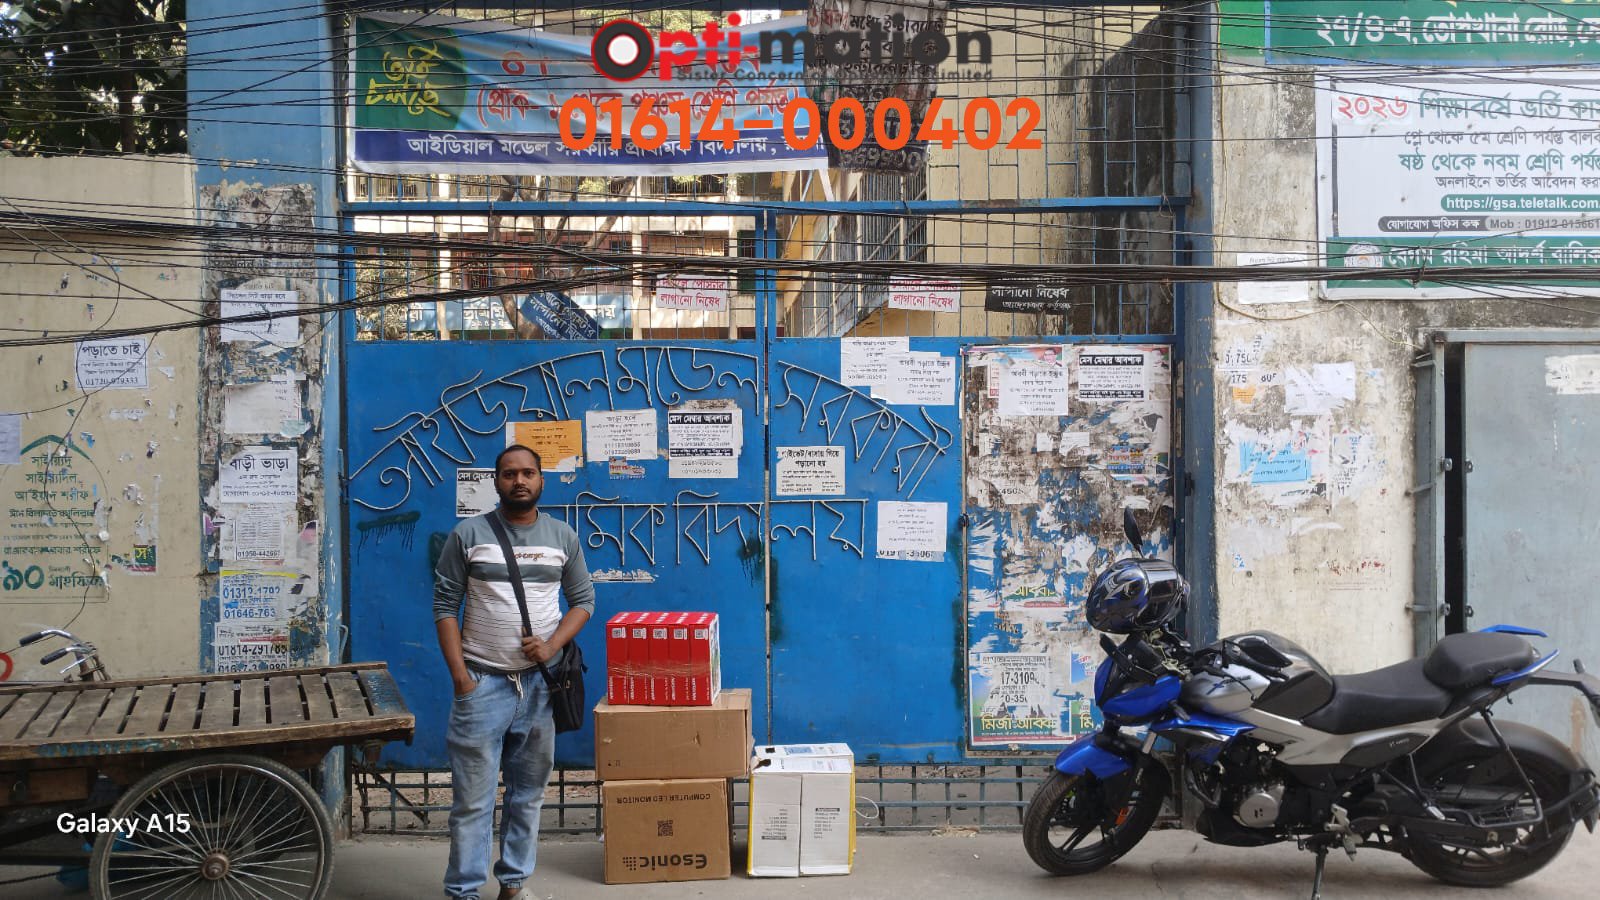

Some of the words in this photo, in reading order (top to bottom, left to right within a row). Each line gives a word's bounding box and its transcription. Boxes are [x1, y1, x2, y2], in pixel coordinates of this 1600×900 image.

[1338, 96, 1408, 119] ২০২৬
[407, 133, 494, 156] আইডিয়াল
[501, 138, 549, 157] মডেল
[1431, 152, 1478, 171] থেকে
[1483, 154, 1520, 171] নবম
[1435, 173, 1491, 188] অনলাইনে
[1490, 218, 1514, 229] Mob
[82, 344, 119, 358] পড়াতে
[122, 342, 142, 355] চাই
[260, 457, 289, 472] ভাড়া
[616, 795, 652, 804] MONITOR
[652, 795, 668, 803] LED
[669, 793, 711, 802] COMPUTER
[639, 853, 708, 872] Esonic
